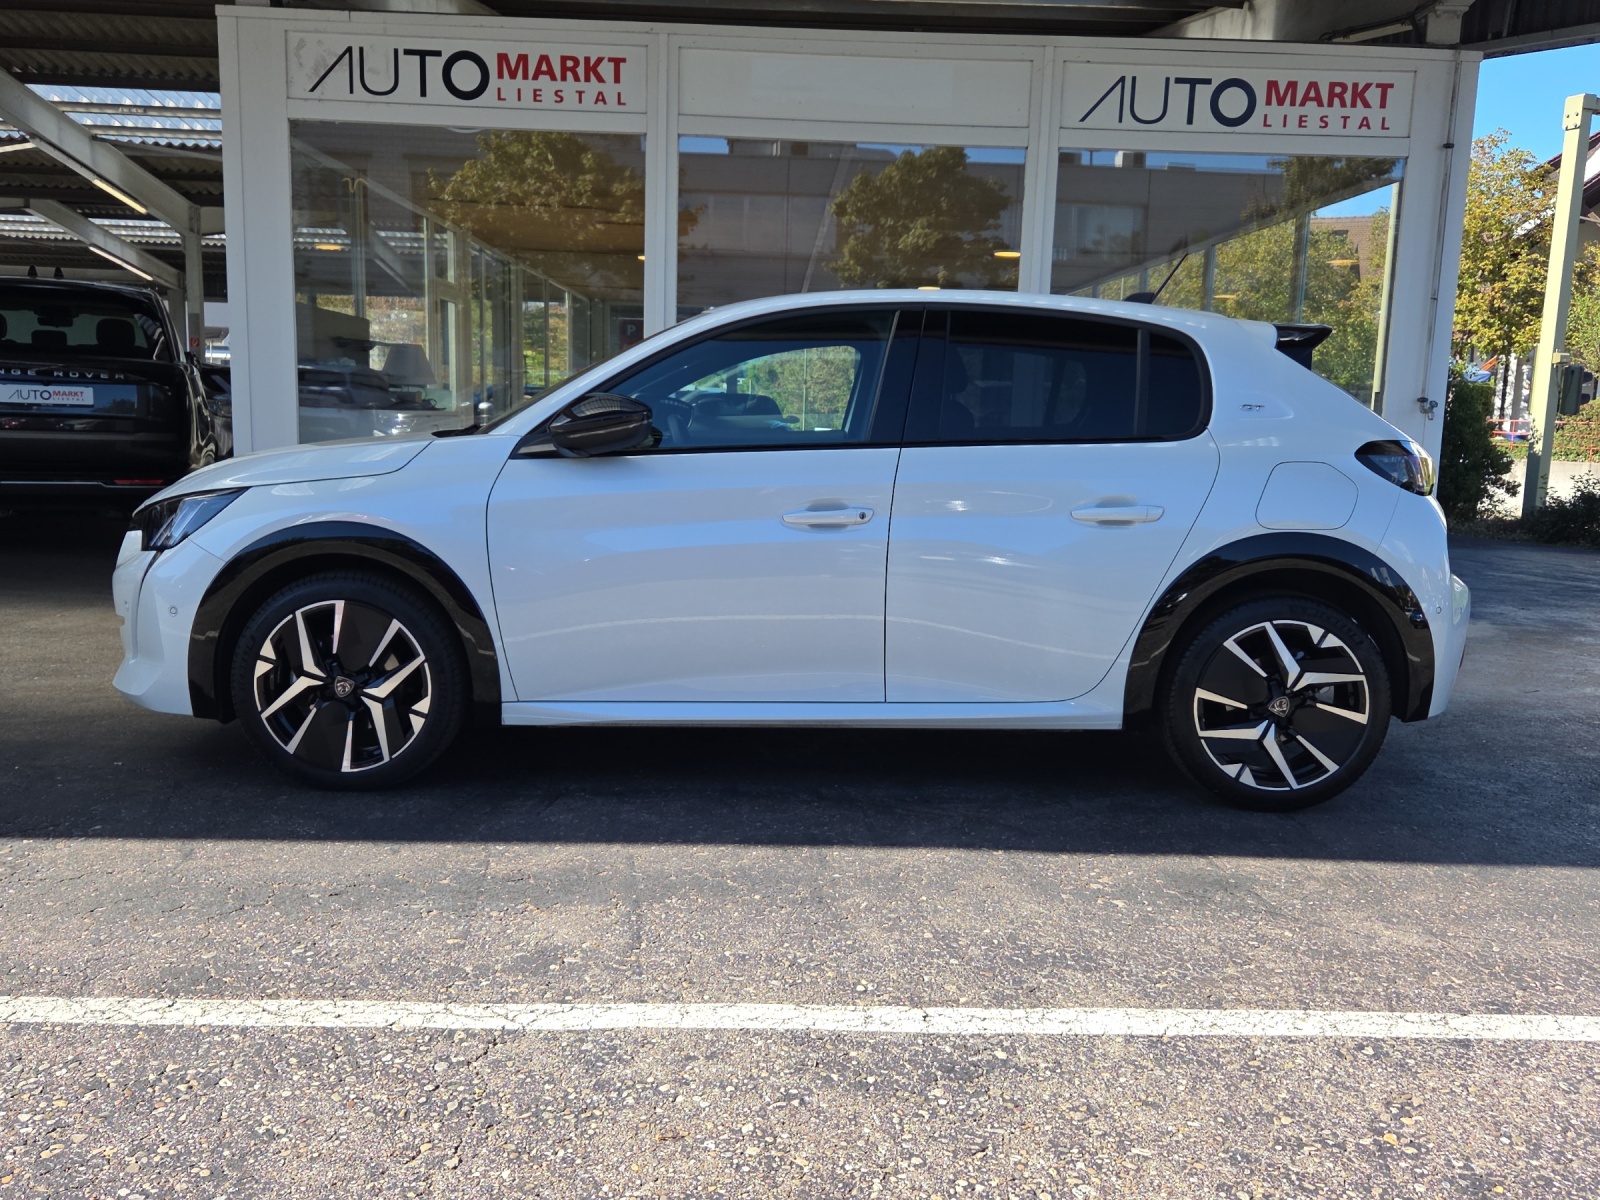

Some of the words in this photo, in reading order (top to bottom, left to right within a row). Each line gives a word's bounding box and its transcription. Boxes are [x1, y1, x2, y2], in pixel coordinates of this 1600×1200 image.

[308, 45, 490, 101] AUTO
[496, 52, 627, 84] MARKT
[496, 87, 627, 106] LIESTAL
[1078, 75, 1257, 127] AUTO
[1264, 80, 1395, 109] MARKT
[1262, 113, 1391, 131] LIESTAL
[53, 371, 125, 379] ROVER
[9, 389, 52, 400] AUTO
